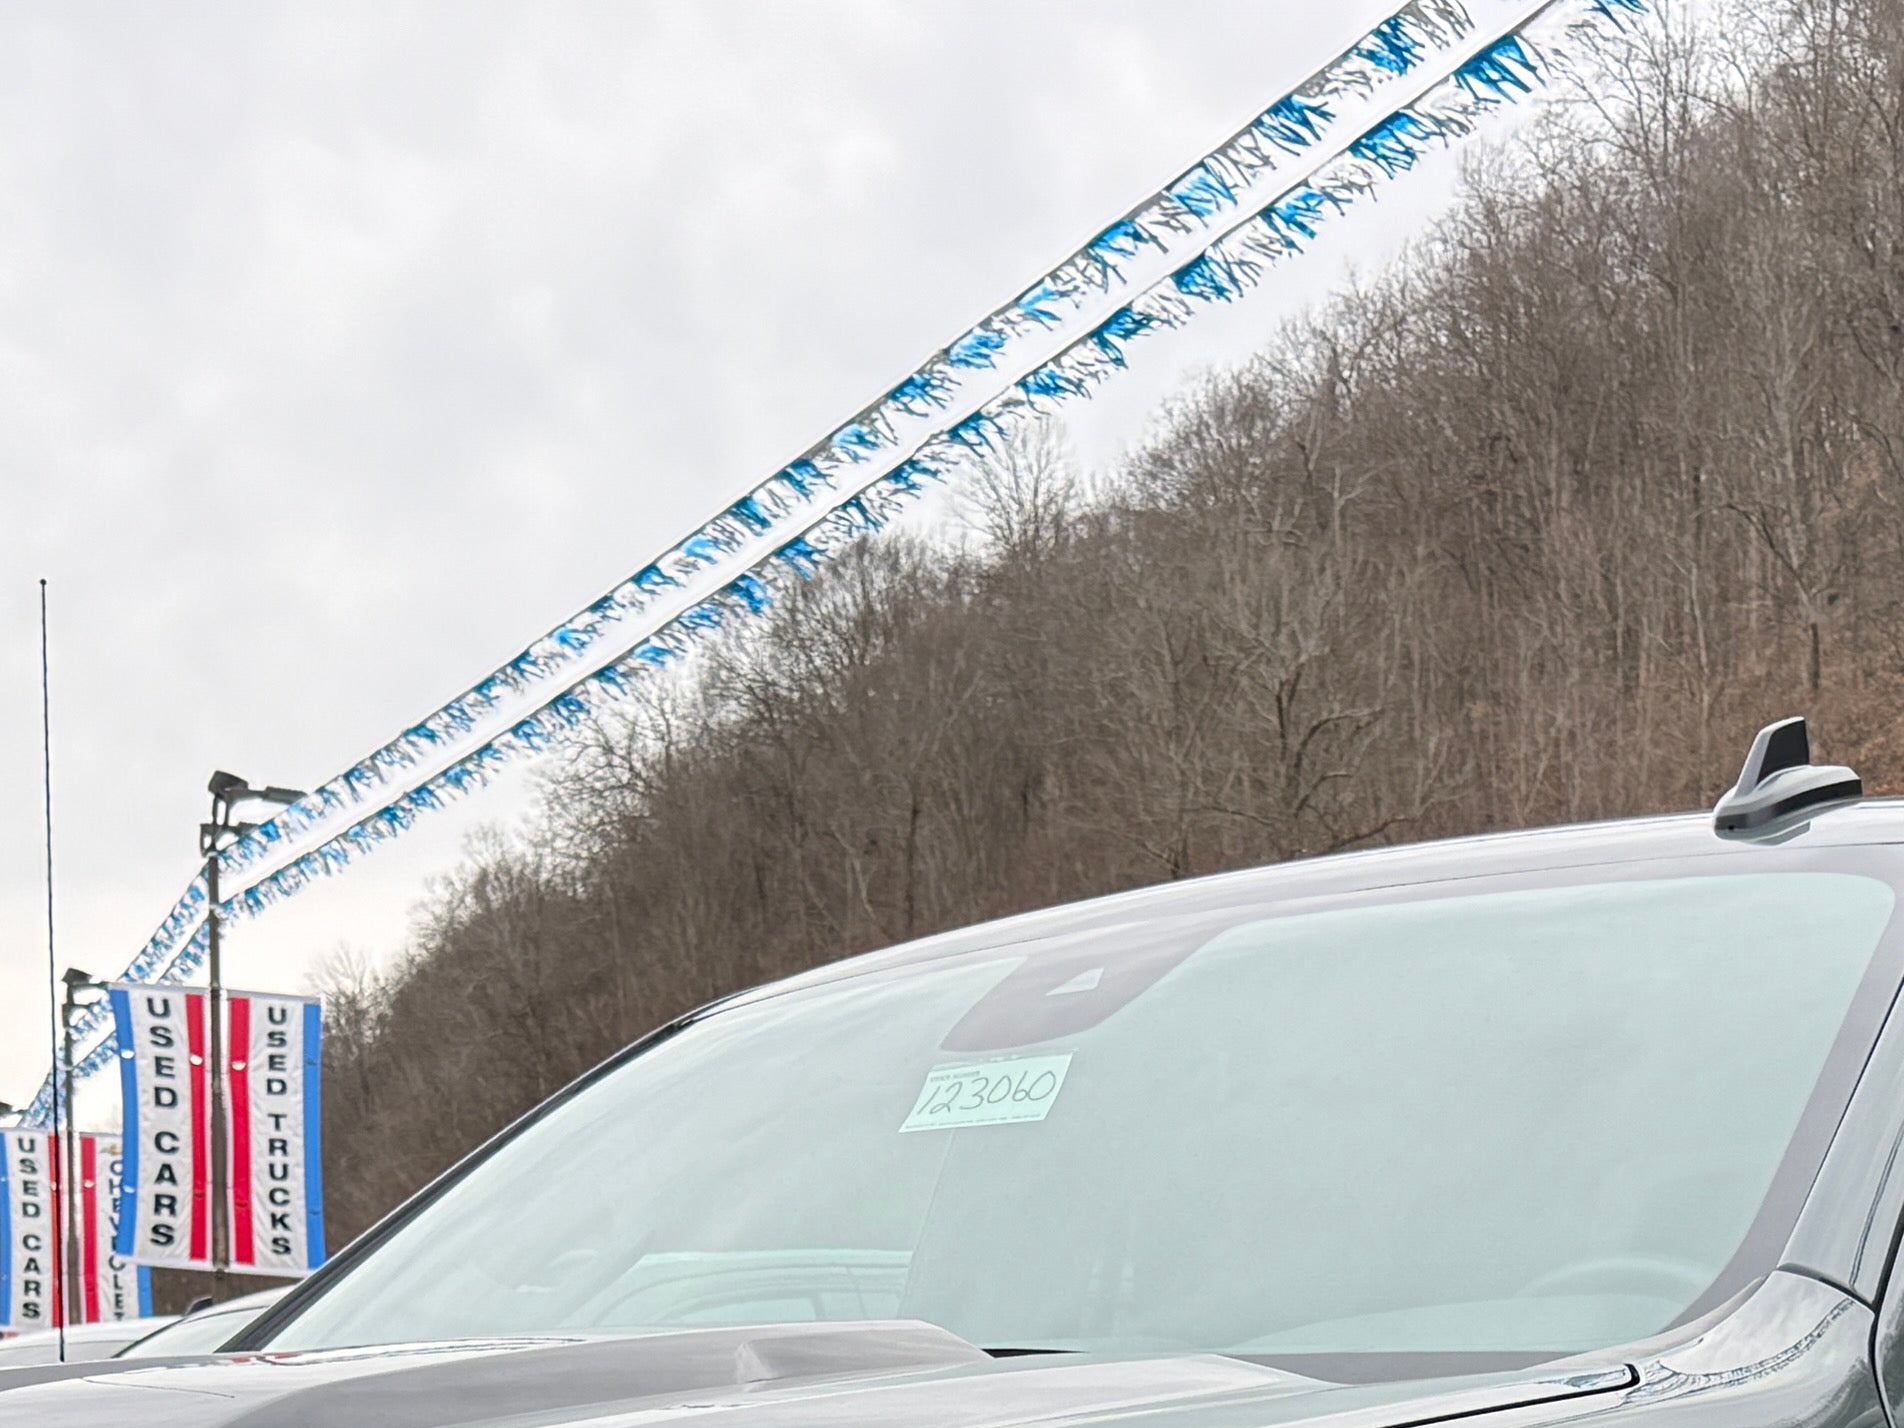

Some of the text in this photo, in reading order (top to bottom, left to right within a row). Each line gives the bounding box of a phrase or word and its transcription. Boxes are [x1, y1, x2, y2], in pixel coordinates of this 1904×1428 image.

[147, 998, 179, 1246] USED CARS
[267, 1007, 291, 1255] USED TRUCKS
[917, 1070, 1057, 1115] 123060
[18, 1138, 42, 1320] USED CARS
